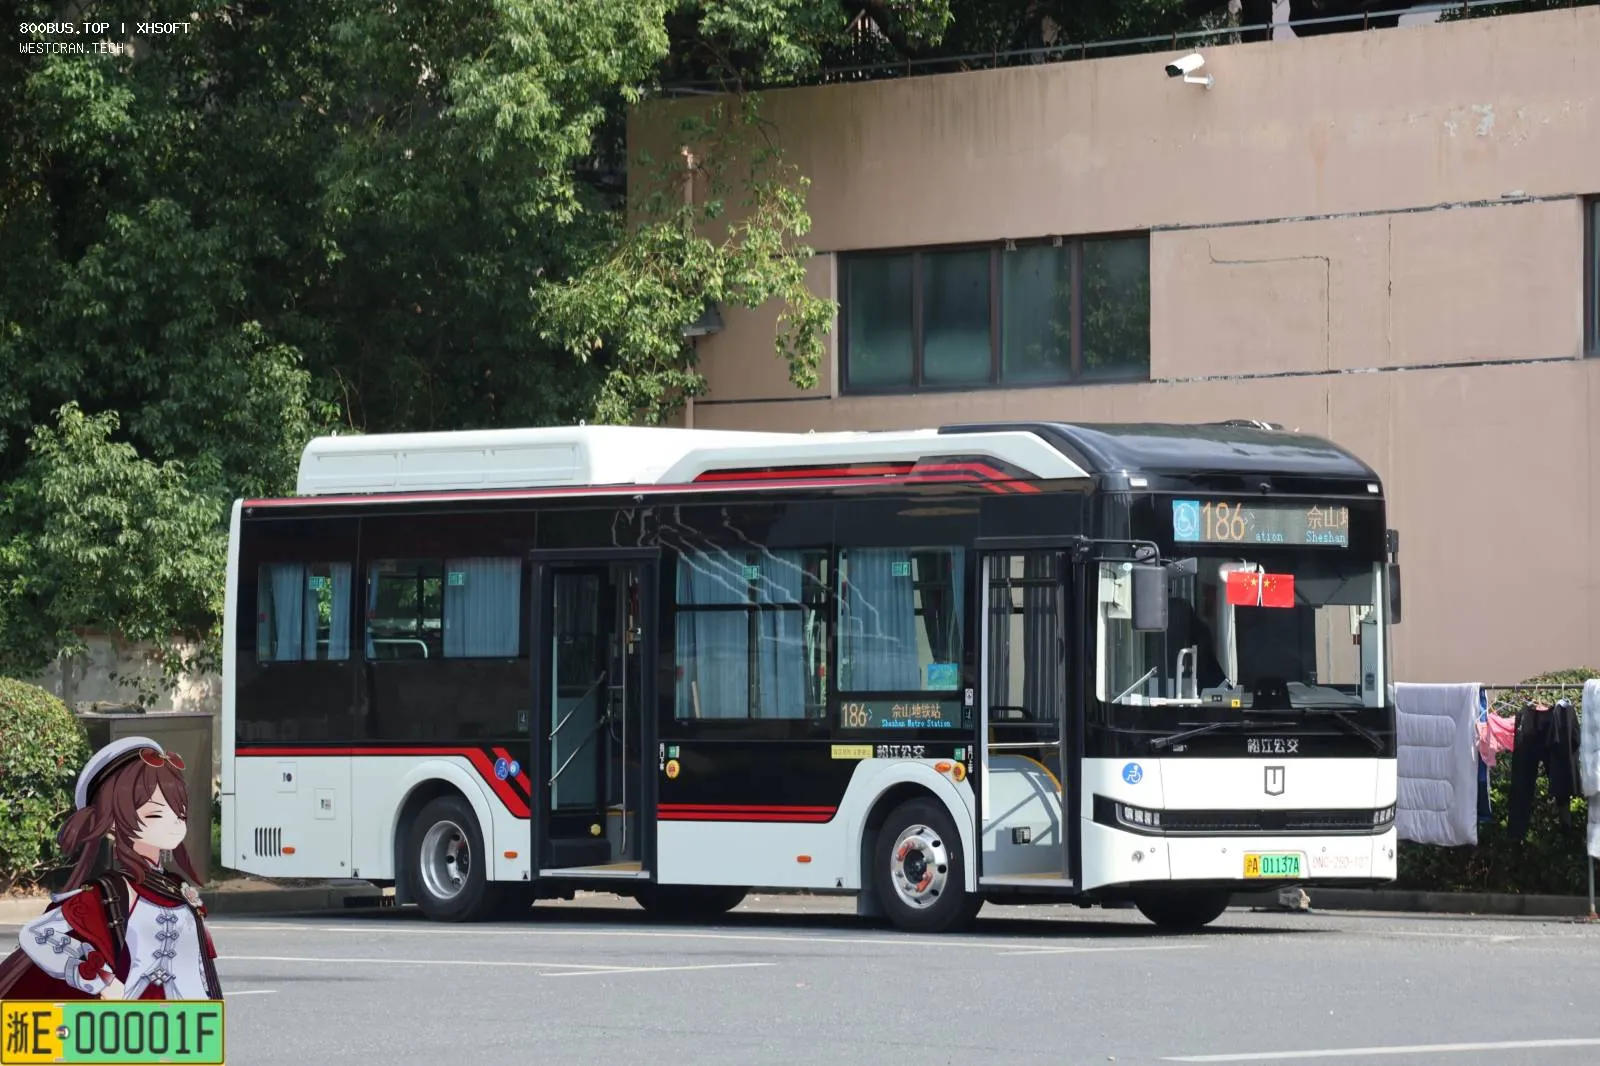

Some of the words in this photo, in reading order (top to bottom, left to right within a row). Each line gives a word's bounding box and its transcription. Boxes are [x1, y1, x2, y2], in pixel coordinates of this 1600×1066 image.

[1203, 502, 1246, 541] 186
[1306, 531, 1346, 543] Sheshan
[842, 703, 867, 728] 186
